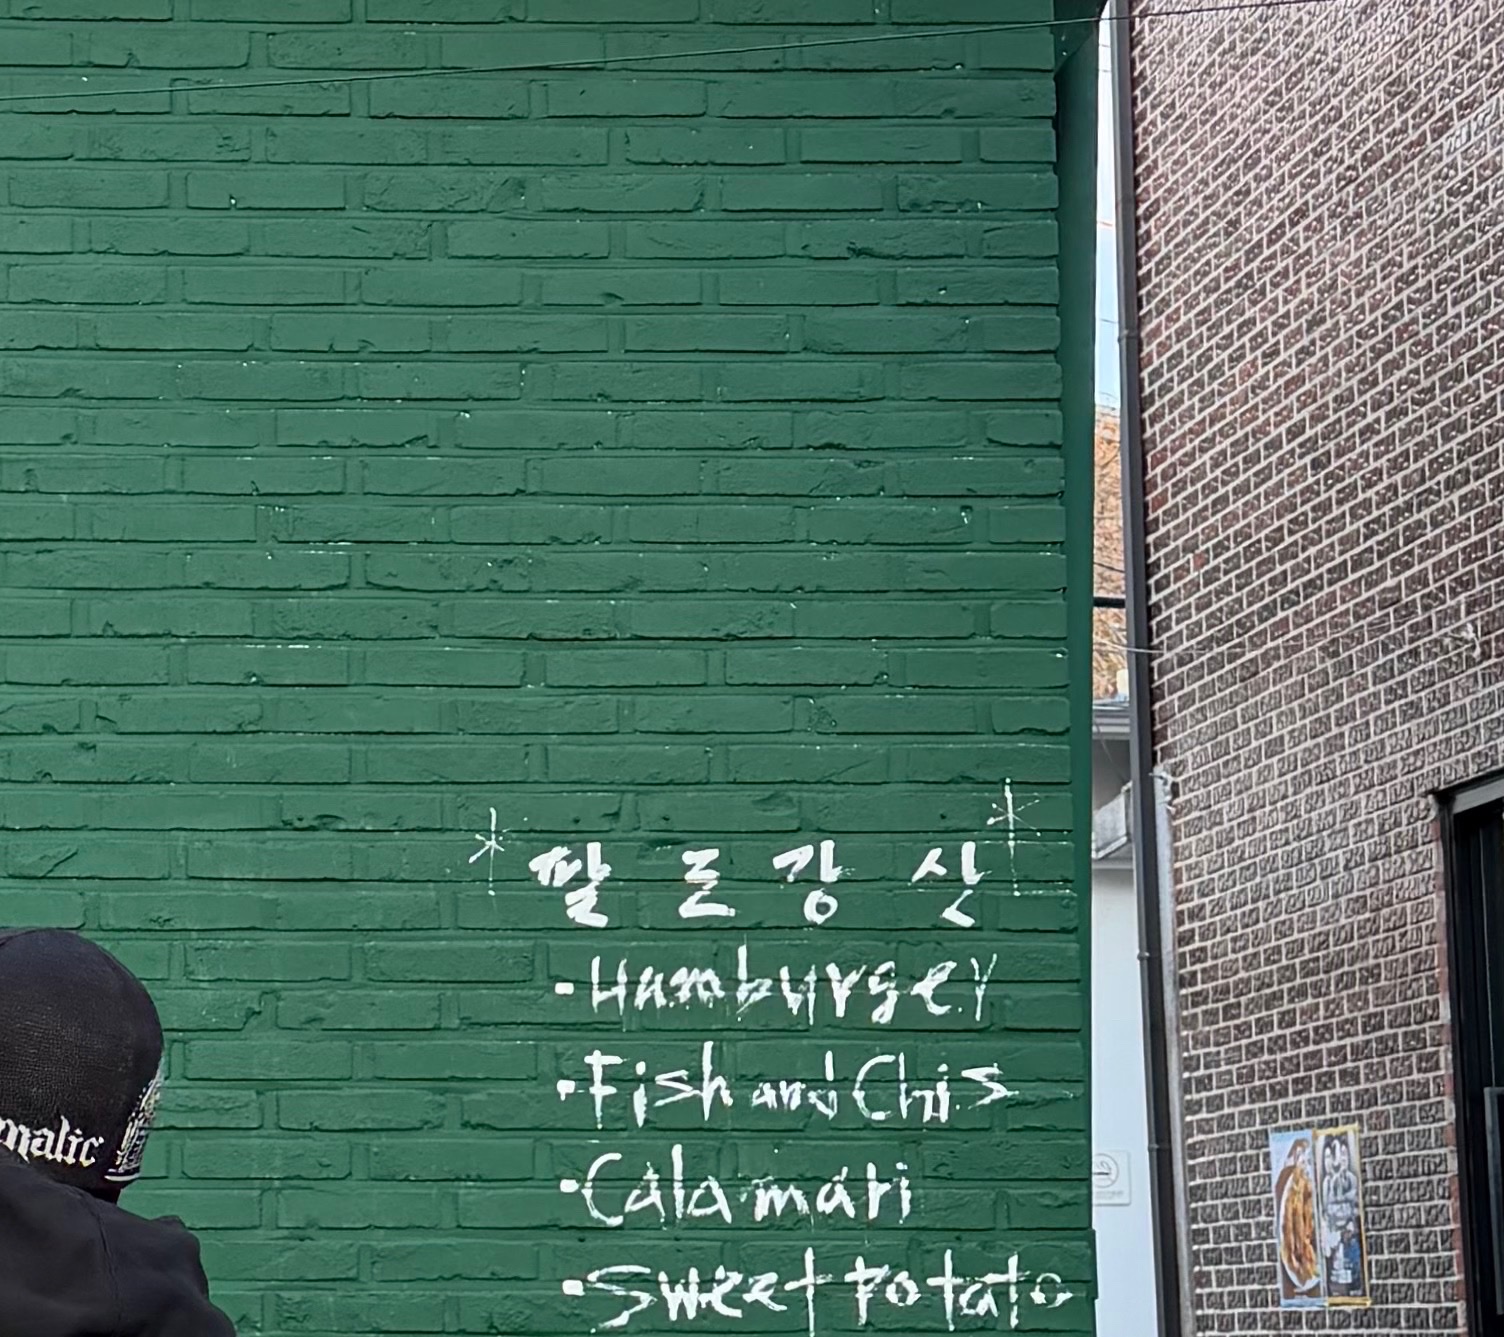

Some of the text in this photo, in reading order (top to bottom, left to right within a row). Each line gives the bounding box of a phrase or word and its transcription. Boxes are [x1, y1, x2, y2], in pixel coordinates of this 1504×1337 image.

[591, 944, 997, 1026] Hamburger
[584, 1041, 734, 1130] Fish
[752, 1050, 838, 1121] and
[582, 1144, 912, 1227] Calamari
[588, 1247, 832, 1337] Sweet
